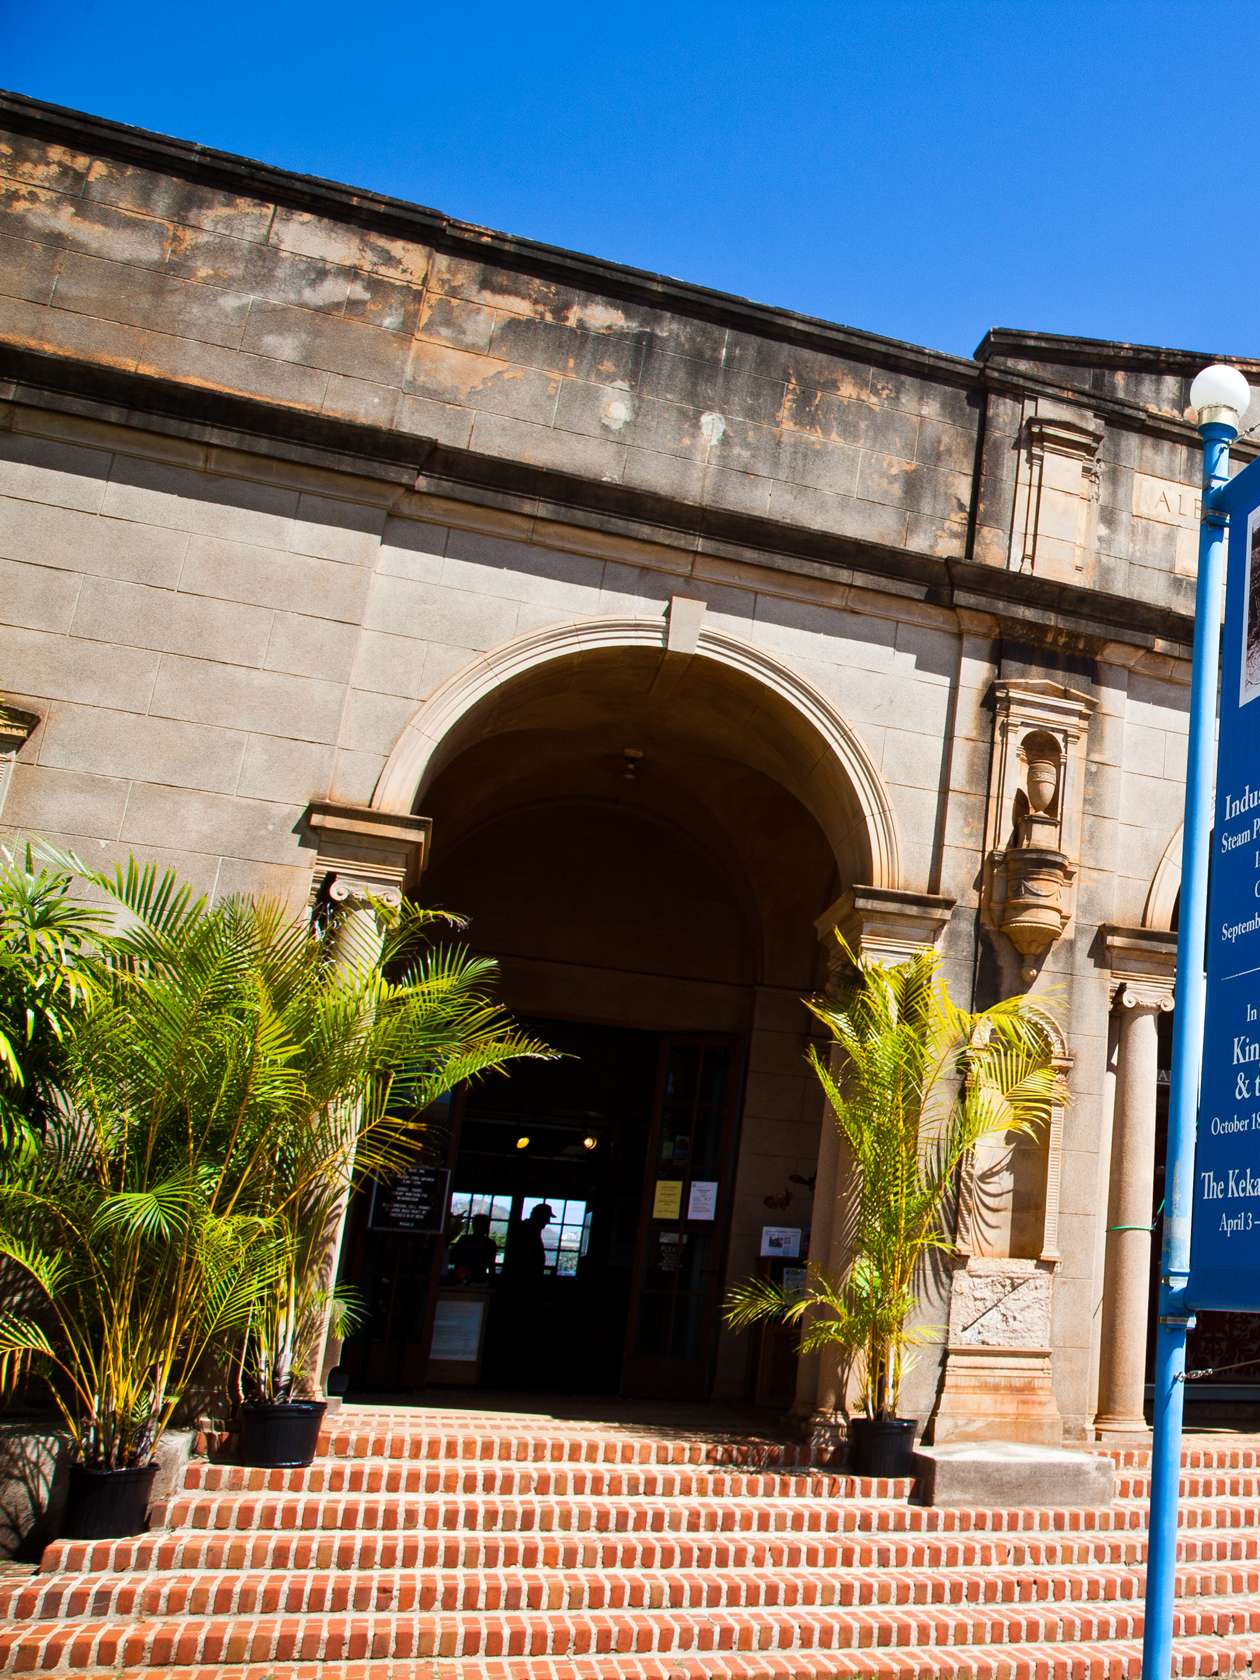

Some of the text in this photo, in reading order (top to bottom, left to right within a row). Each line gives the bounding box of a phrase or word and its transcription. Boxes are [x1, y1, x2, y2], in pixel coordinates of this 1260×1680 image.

[1222, 828, 1250, 853] Steam
[1247, 1004, 1257, 1022] In
[1235, 1072, 1251, 1099] &
[1211, 1114, 1249, 1135] October
[1201, 1171, 1224, 1199] The
[1219, 1213, 1245, 1237] April
[1246, 1215, 1252, 1230] 3
